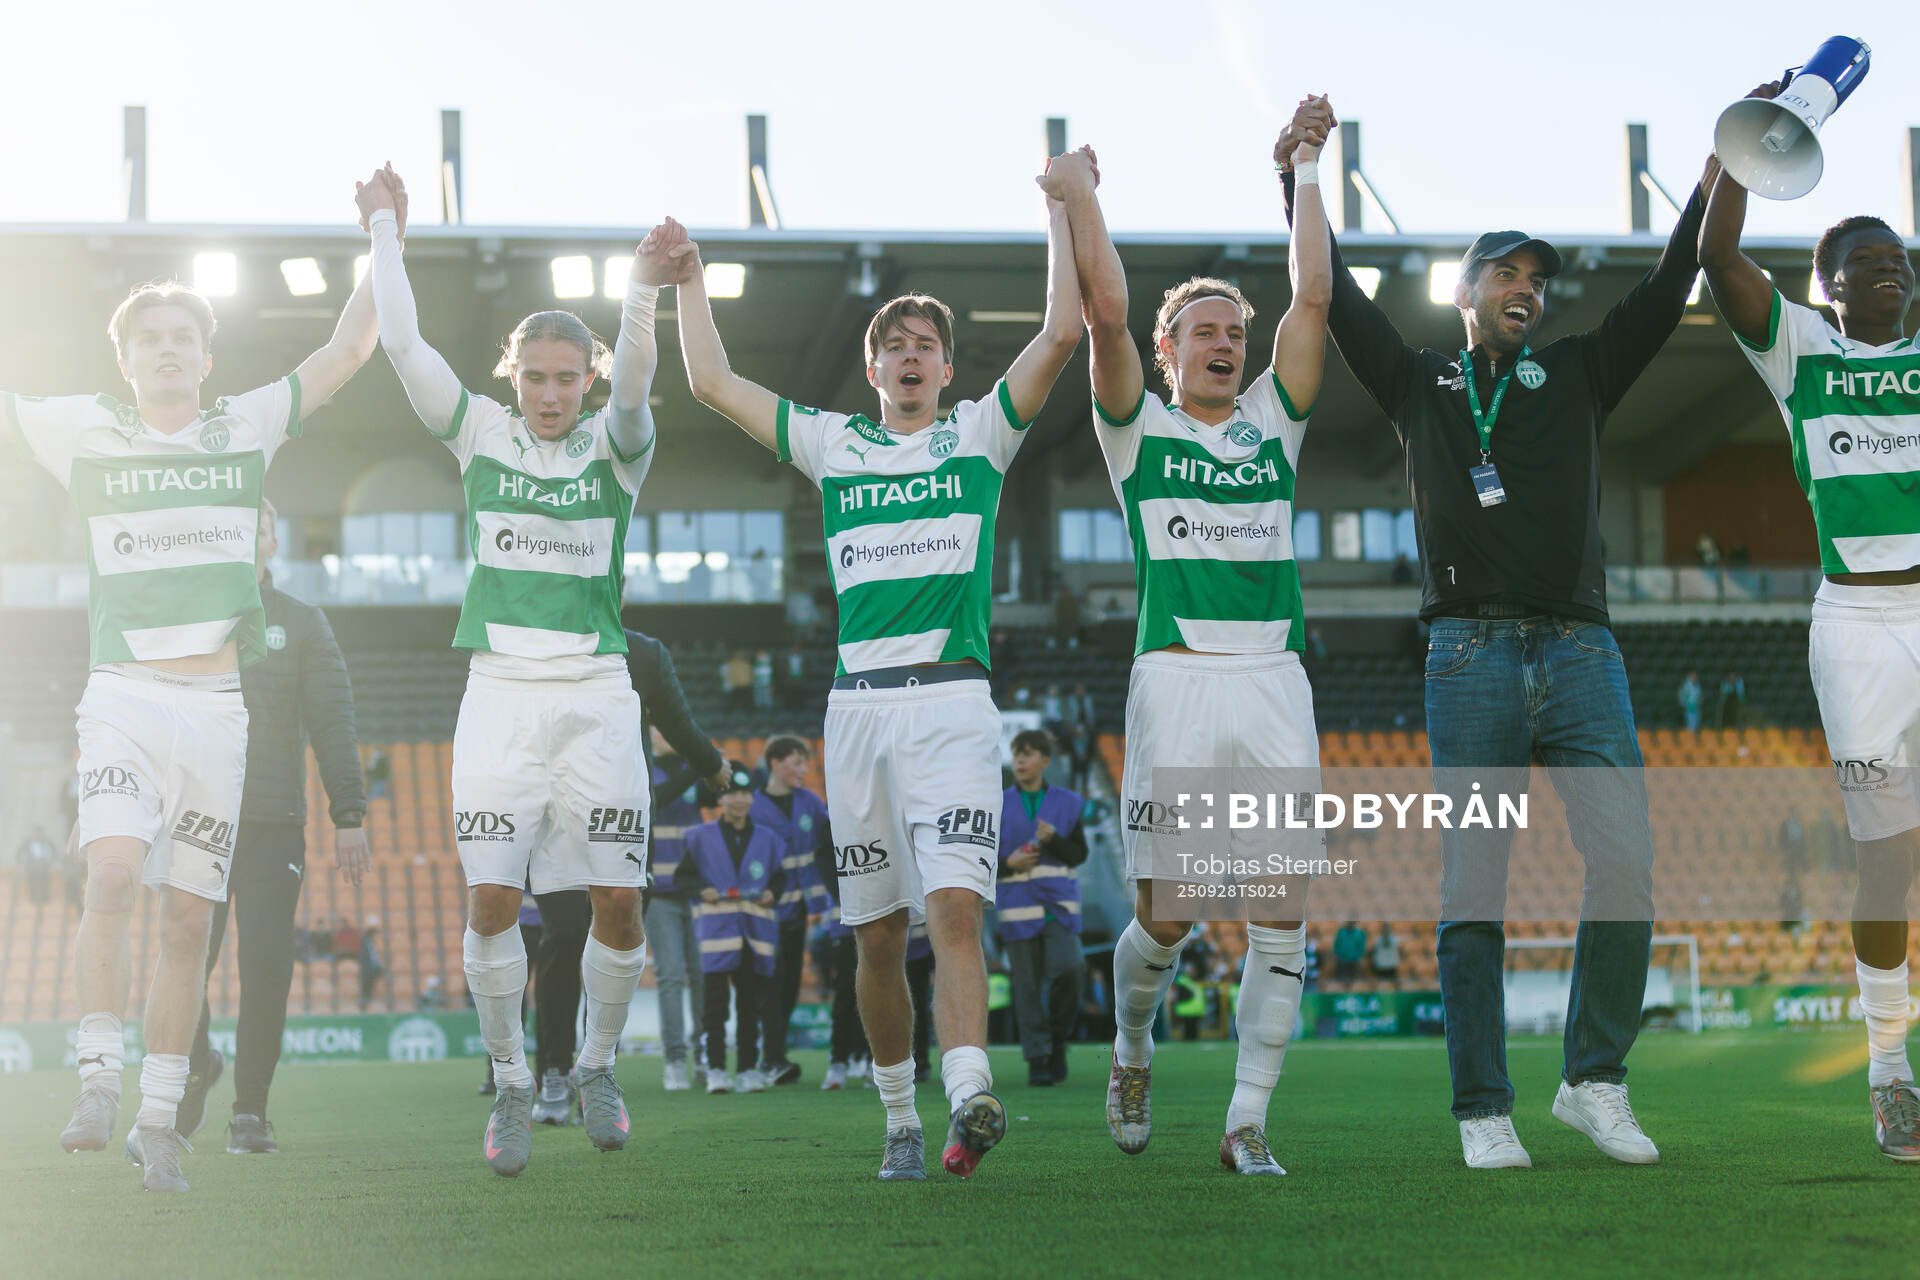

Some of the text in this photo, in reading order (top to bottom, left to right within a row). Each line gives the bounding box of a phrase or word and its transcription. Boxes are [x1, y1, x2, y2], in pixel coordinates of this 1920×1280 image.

[104, 466, 243, 496] HITACHI
[1163, 455, 1279, 486] HITACHI
[498, 473, 600, 506] HITACHI
[840, 474, 962, 513] HITACHI
[138, 524, 244, 551] Hygienteknik
[856, 534, 961, 563] Hygienteknik
[1850, 782, 1890, 792] BILGLAS
[588, 808, 645, 834] SPOL
[937, 808, 996, 839] SPOL
[1140, 825, 1182, 836] BILGLAS
[474, 835, 515, 843] BILGLAS
[835, 839, 888, 870] YDS
[849, 862, 891, 876] BILGLAS
[1773, 995, 1845, 1022] SKYLT
[283, 1026, 363, 1053] NEON
